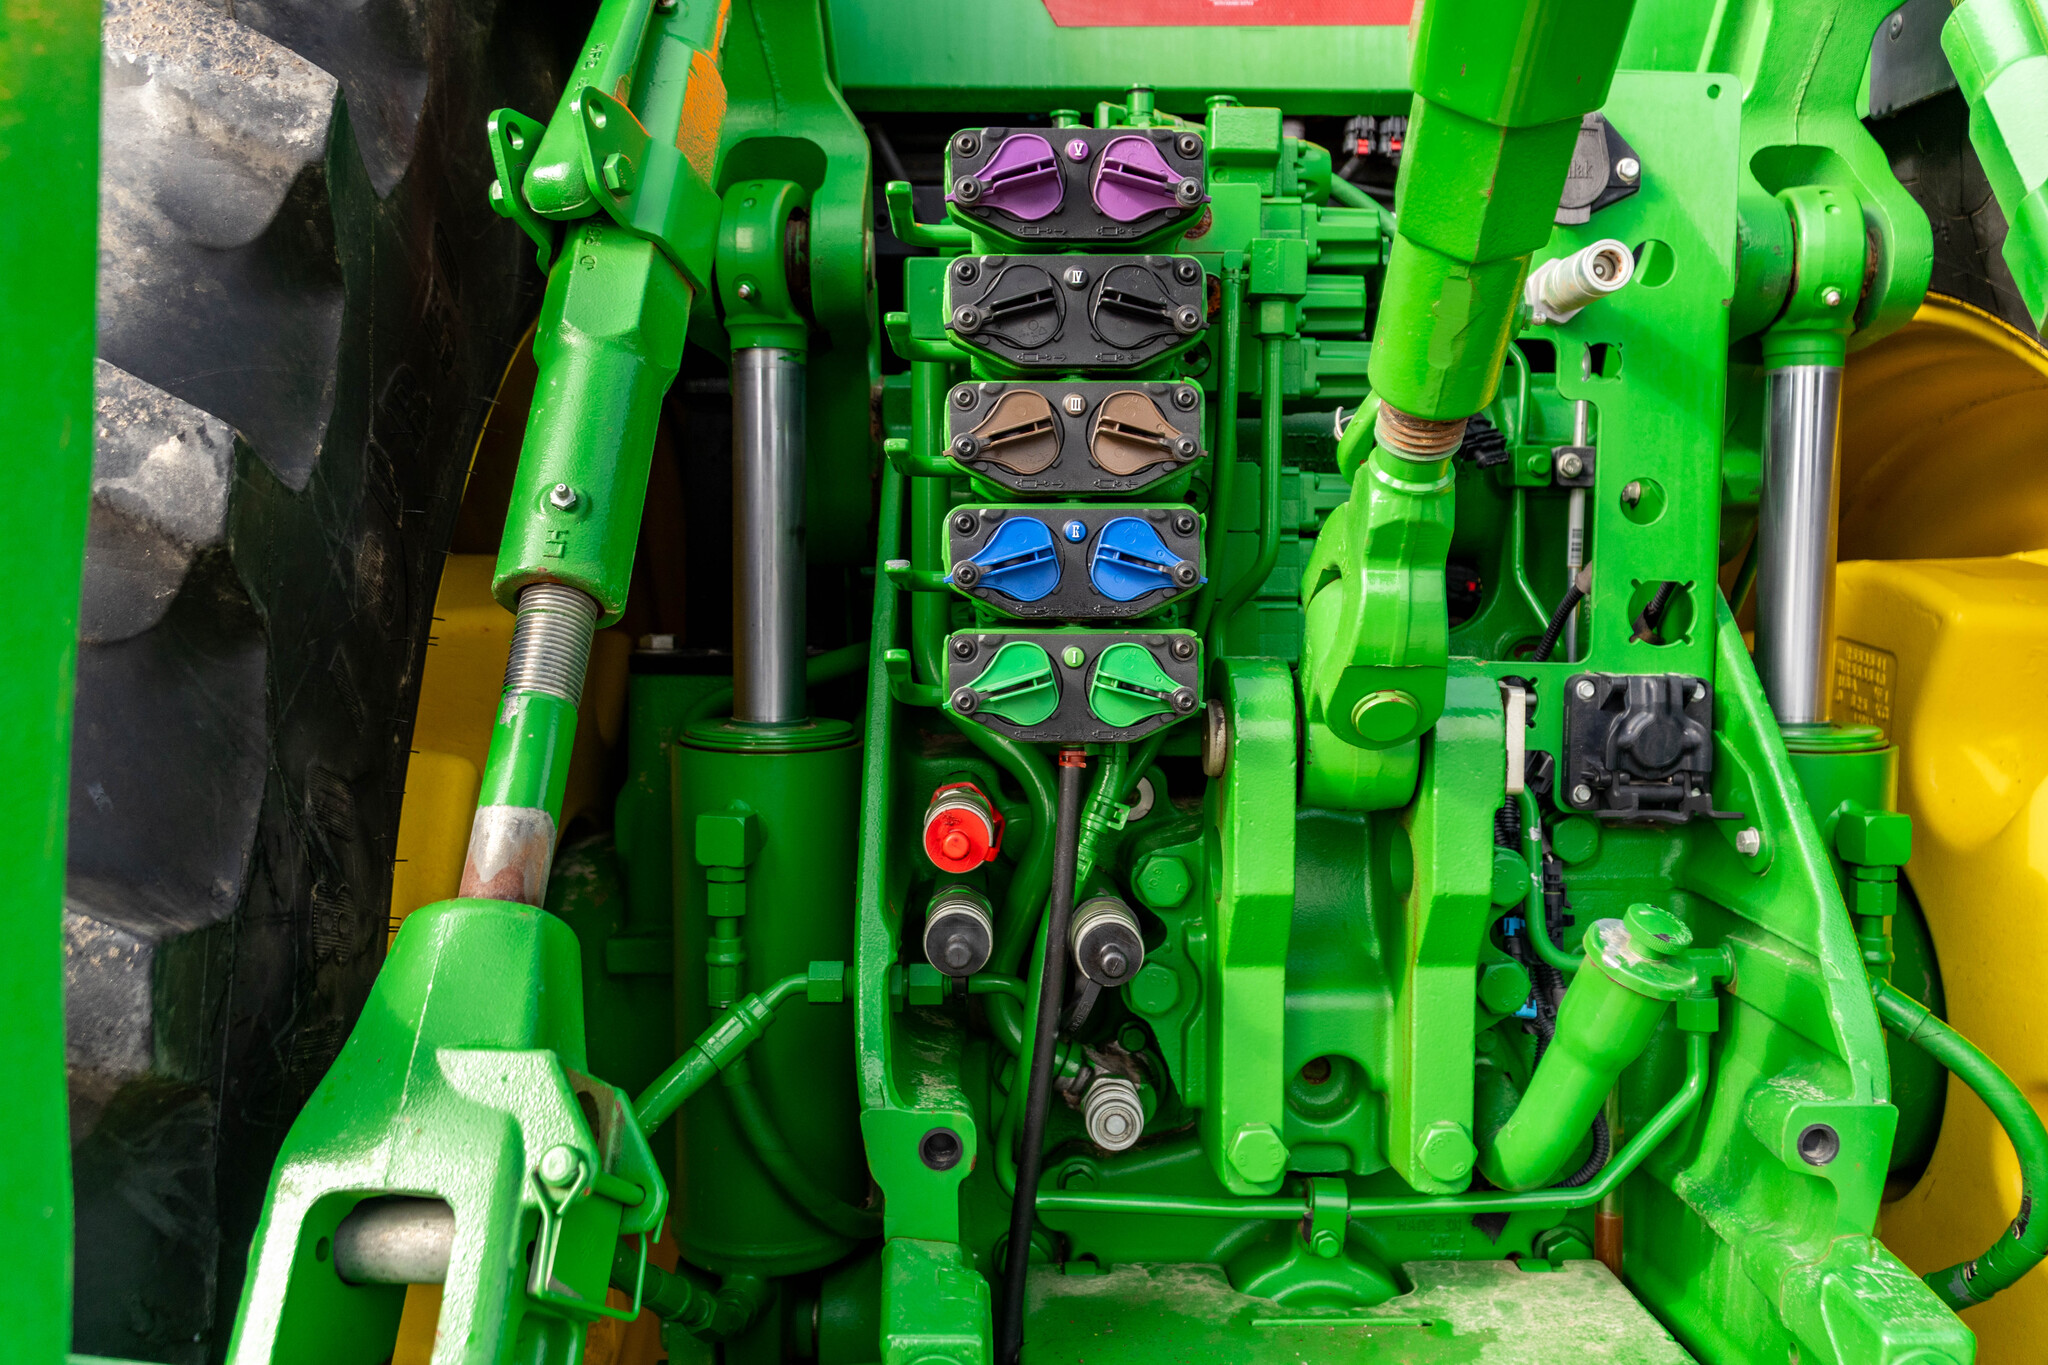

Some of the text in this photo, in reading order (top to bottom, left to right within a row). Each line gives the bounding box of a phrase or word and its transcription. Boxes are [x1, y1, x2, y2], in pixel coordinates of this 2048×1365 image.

[1074, 142, 1084, 156] V
[1072, 270, 1083, 283] IV
[1071, 397, 1081, 411] III
[1072, 650, 1077, 663] I
